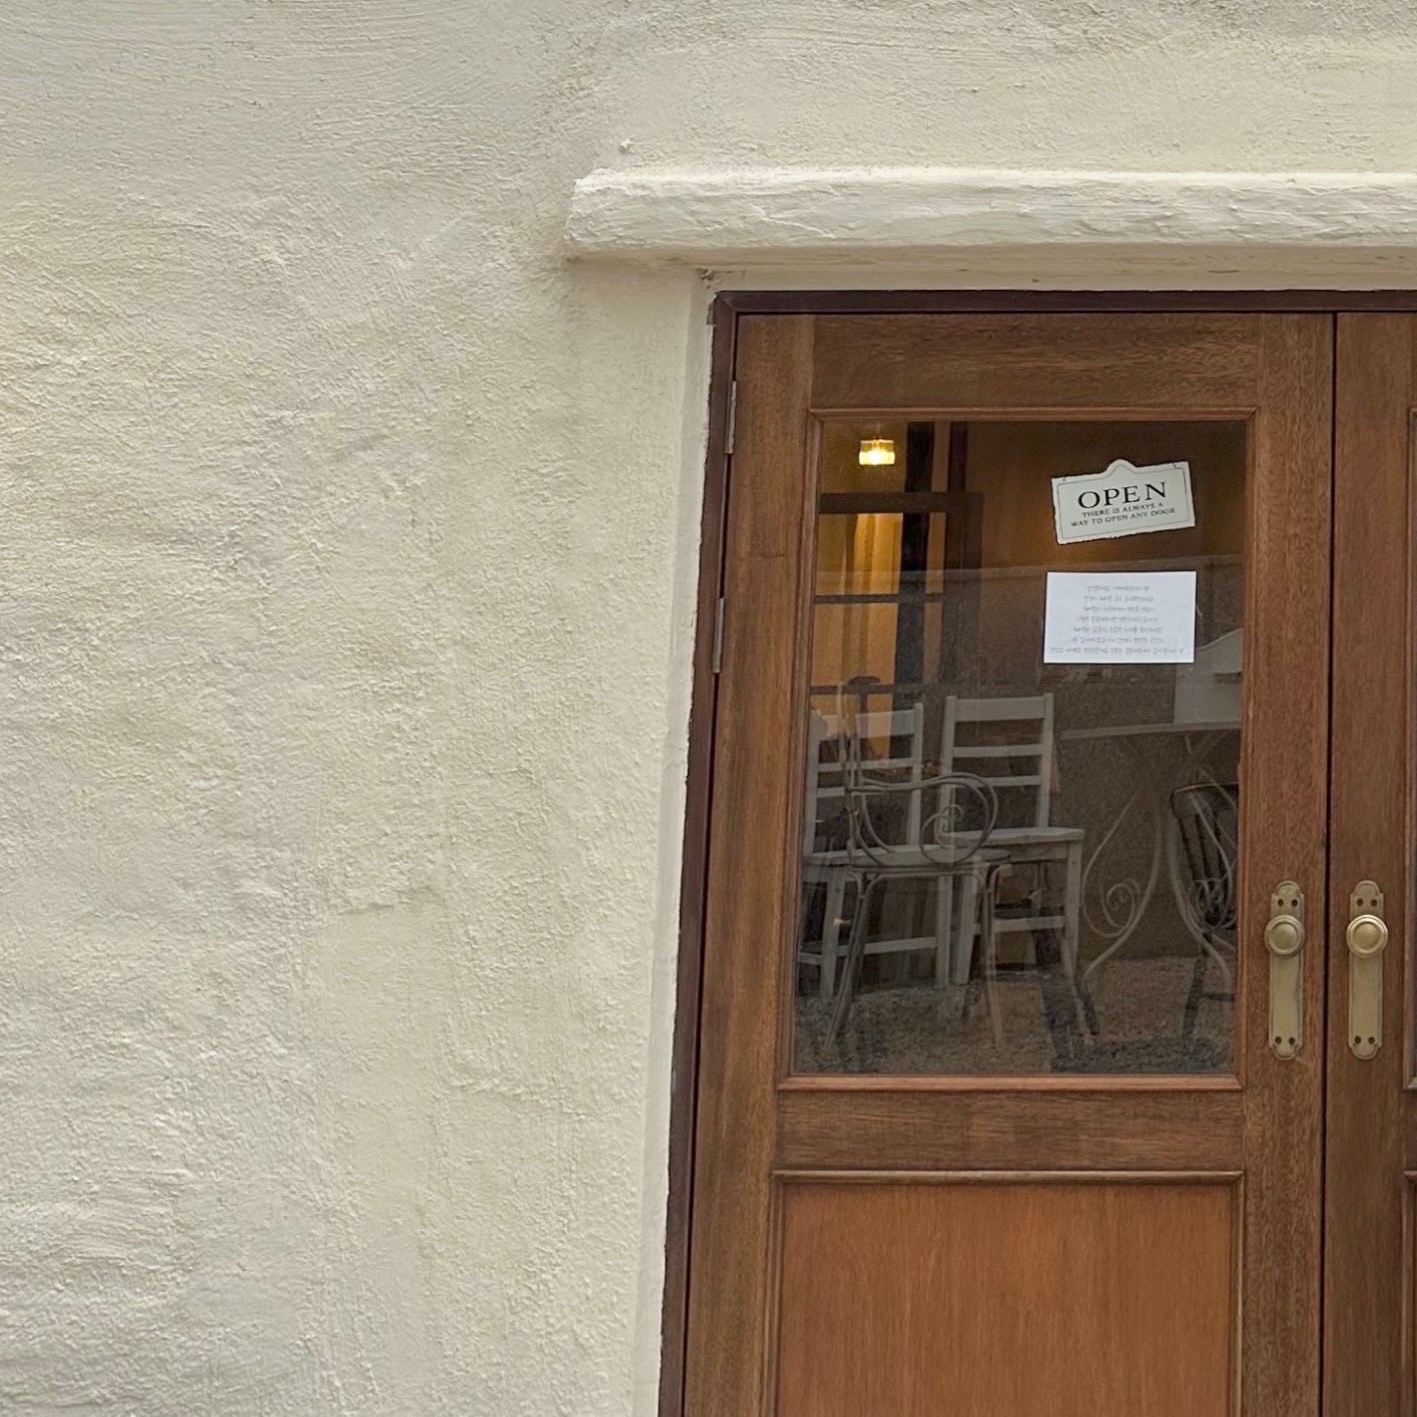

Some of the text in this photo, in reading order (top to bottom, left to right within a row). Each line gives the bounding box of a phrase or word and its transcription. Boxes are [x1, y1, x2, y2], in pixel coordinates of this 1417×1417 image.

[1077, 481, 1168, 510] OPEN
[1070, 507, 1176, 527] WAY TO OPEN ANY DOOR
[1082, 508, 1112, 518] THERE
[1121, 503, 1155, 513] ALWAYS
